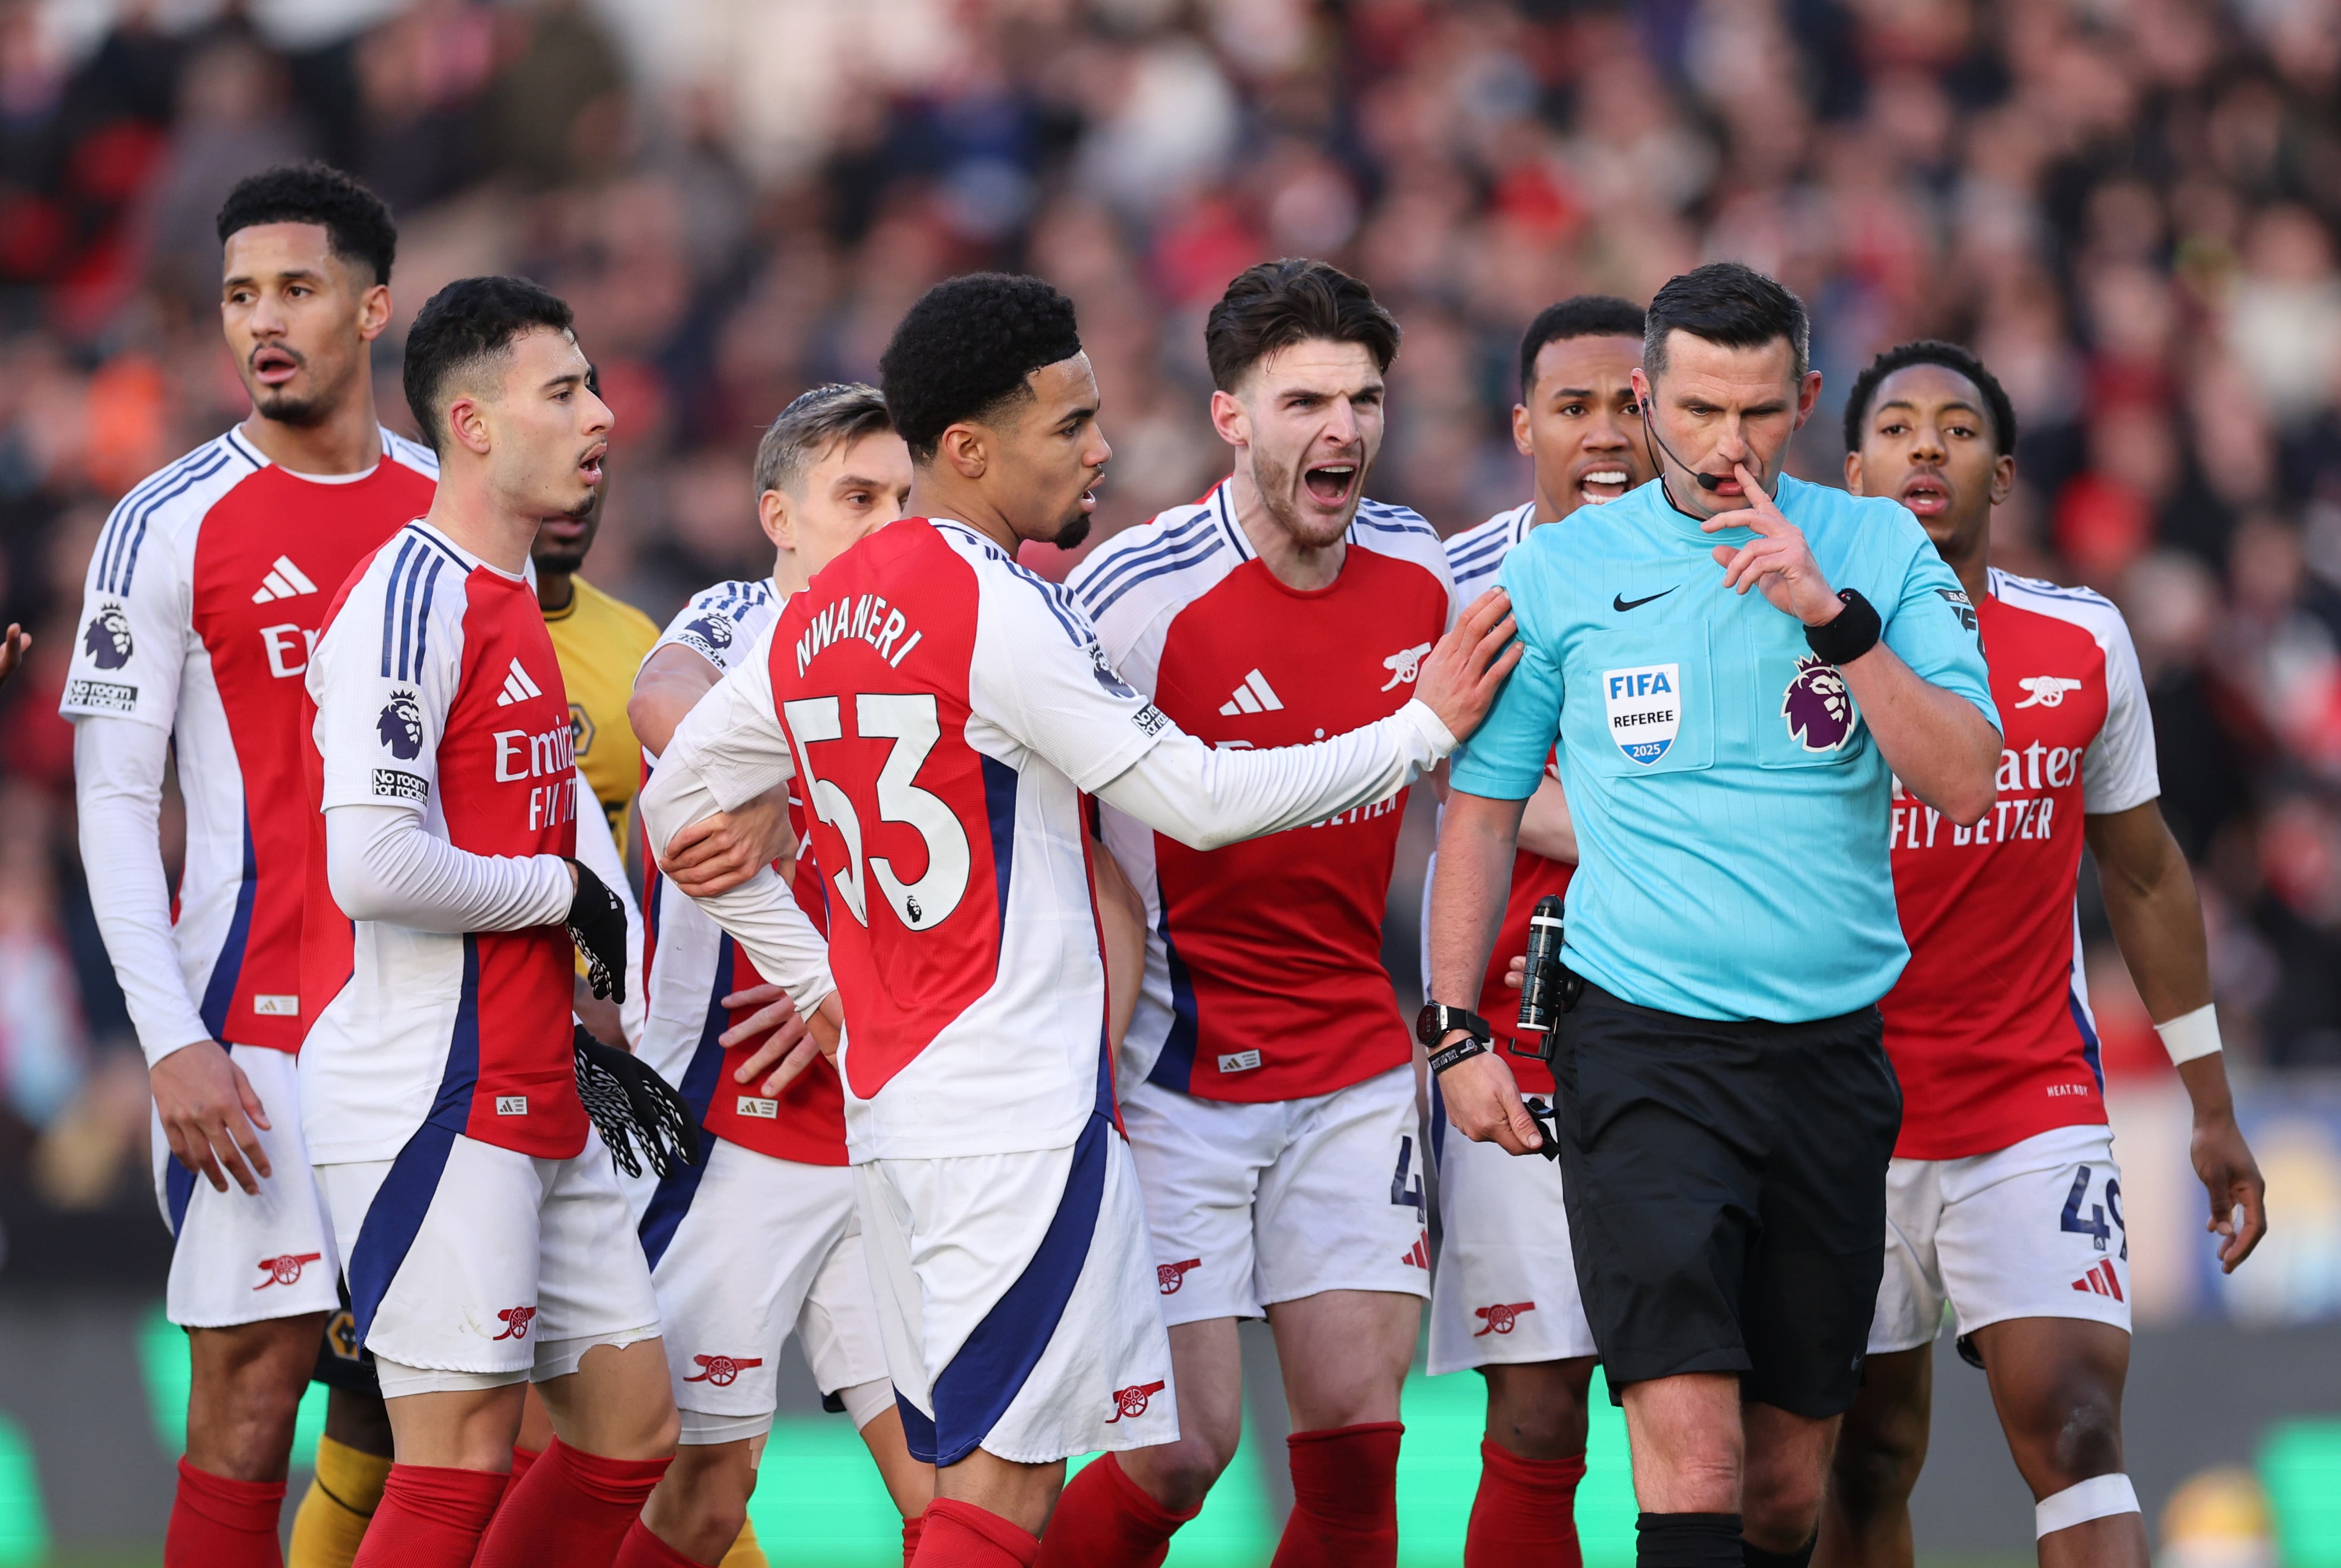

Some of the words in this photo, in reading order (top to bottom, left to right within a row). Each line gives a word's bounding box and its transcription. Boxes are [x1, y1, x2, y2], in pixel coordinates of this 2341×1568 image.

[796, 593, 923, 680] NWANERI
[68, 680, 90, 695] No
[89, 682, 132, 700] room
[1610, 672, 1672, 700] FIFA
[1131, 711, 1151, 730] No
[1141, 720, 1159, 738] for
[1614, 710, 1674, 728] REFEREE
[1632, 744, 1661, 757] 2025
[372, 769, 395, 784] No
[396, 773, 426, 793] room
[372, 781, 395, 795] for
[396, 785, 429, 808] racism
[783, 693, 971, 932] 53
[1889, 806, 1940, 849] FLY
[2060, 1165, 2128, 1262] 49
